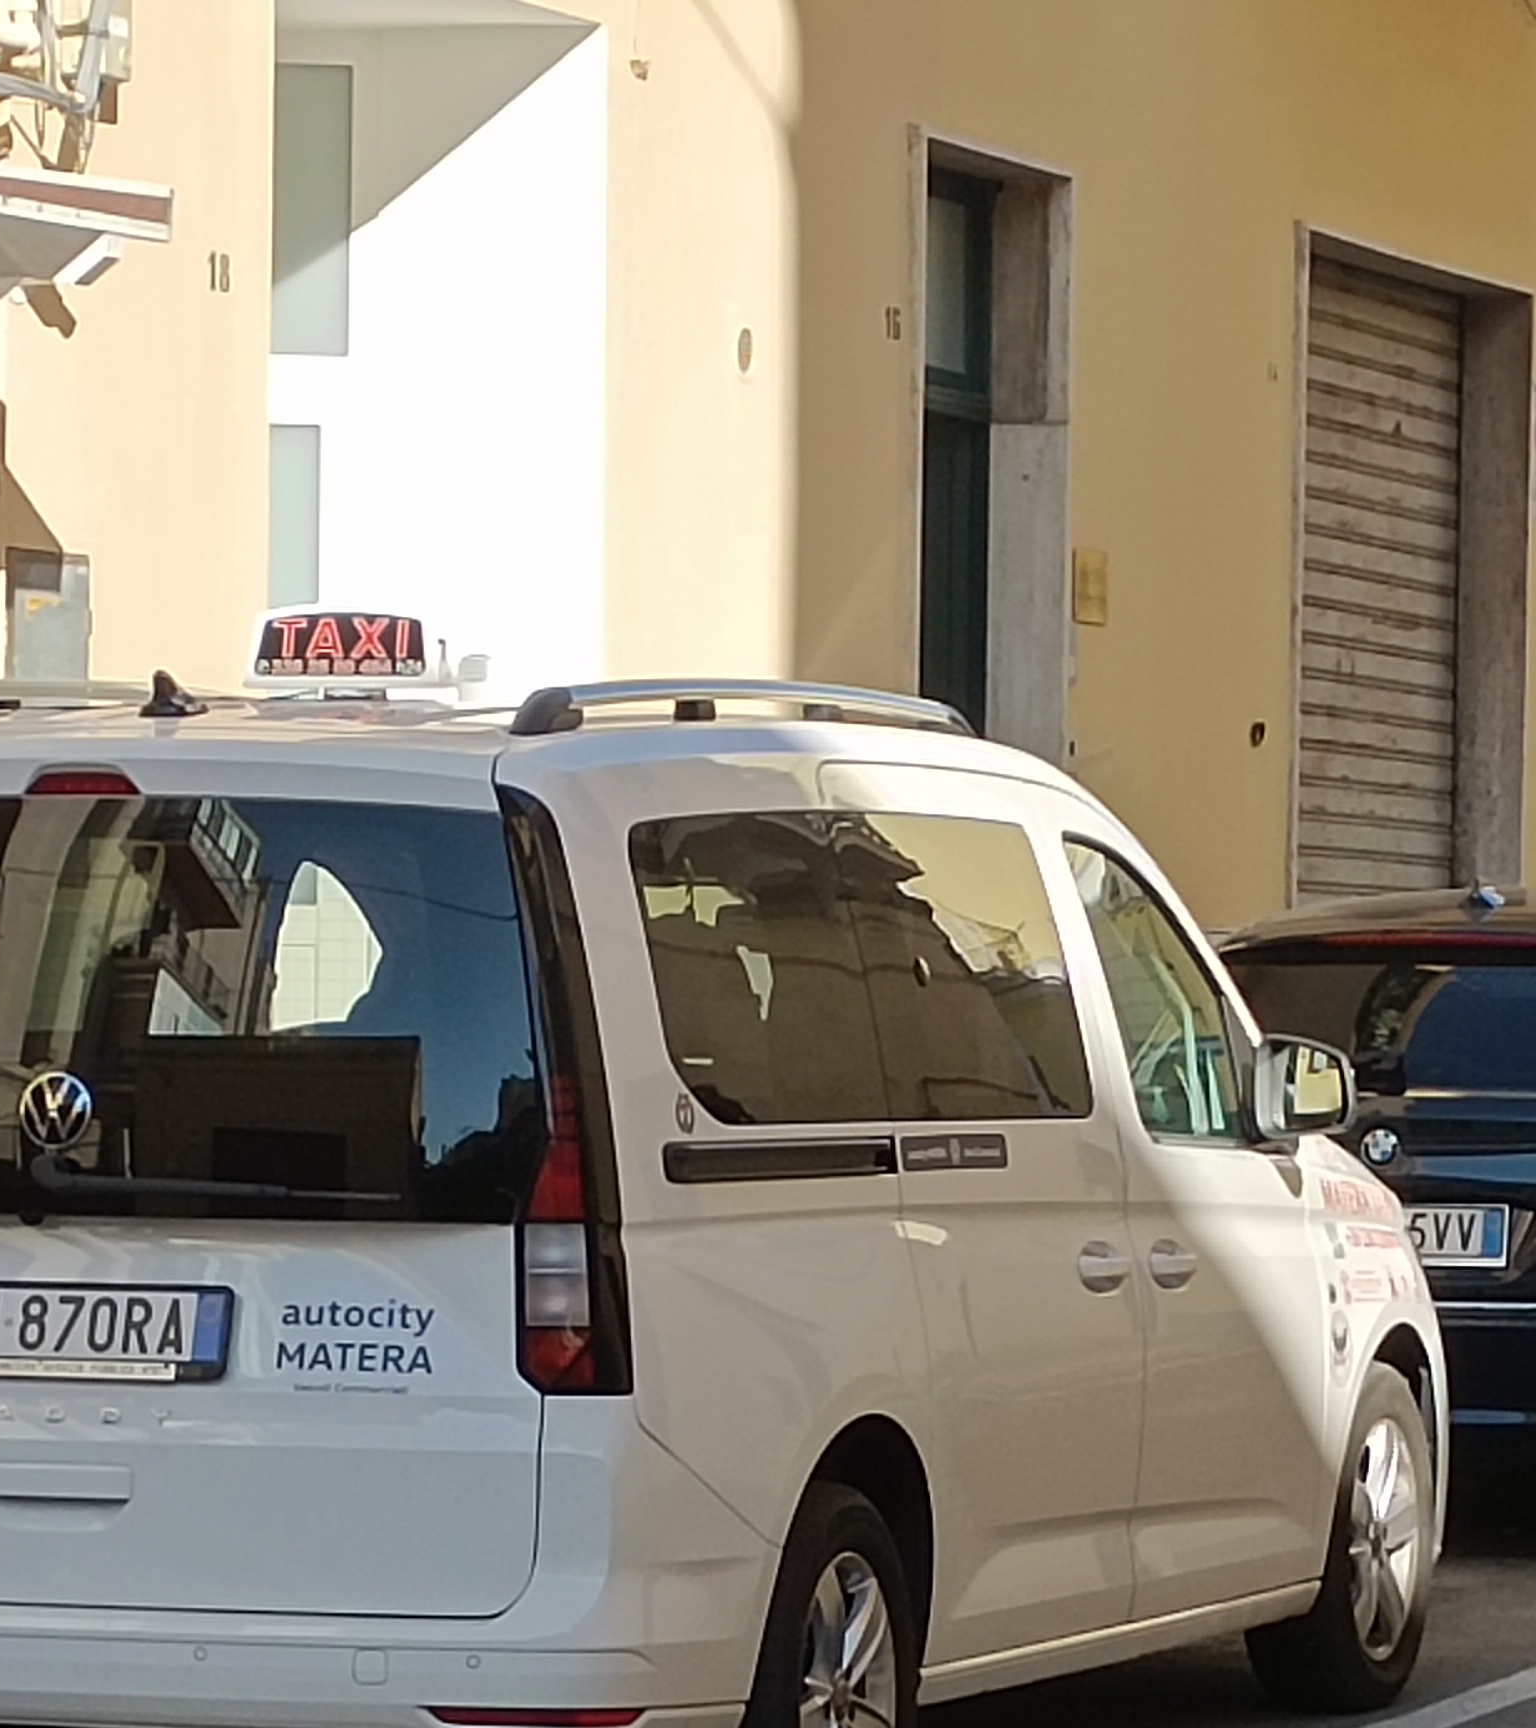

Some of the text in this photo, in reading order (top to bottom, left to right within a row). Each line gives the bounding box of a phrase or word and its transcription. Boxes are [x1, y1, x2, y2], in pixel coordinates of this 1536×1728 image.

[206, 249, 230, 293] 18
[884, 306, 901, 341] 16
[272, 617, 410, 659] TAXI
[1407, 1212, 1476, 1251] 5VV
[18, 1295, 183, 1354] 870RA
[281, 1298, 435, 1337] autocity
[276, 1341, 433, 1375] MATERA
